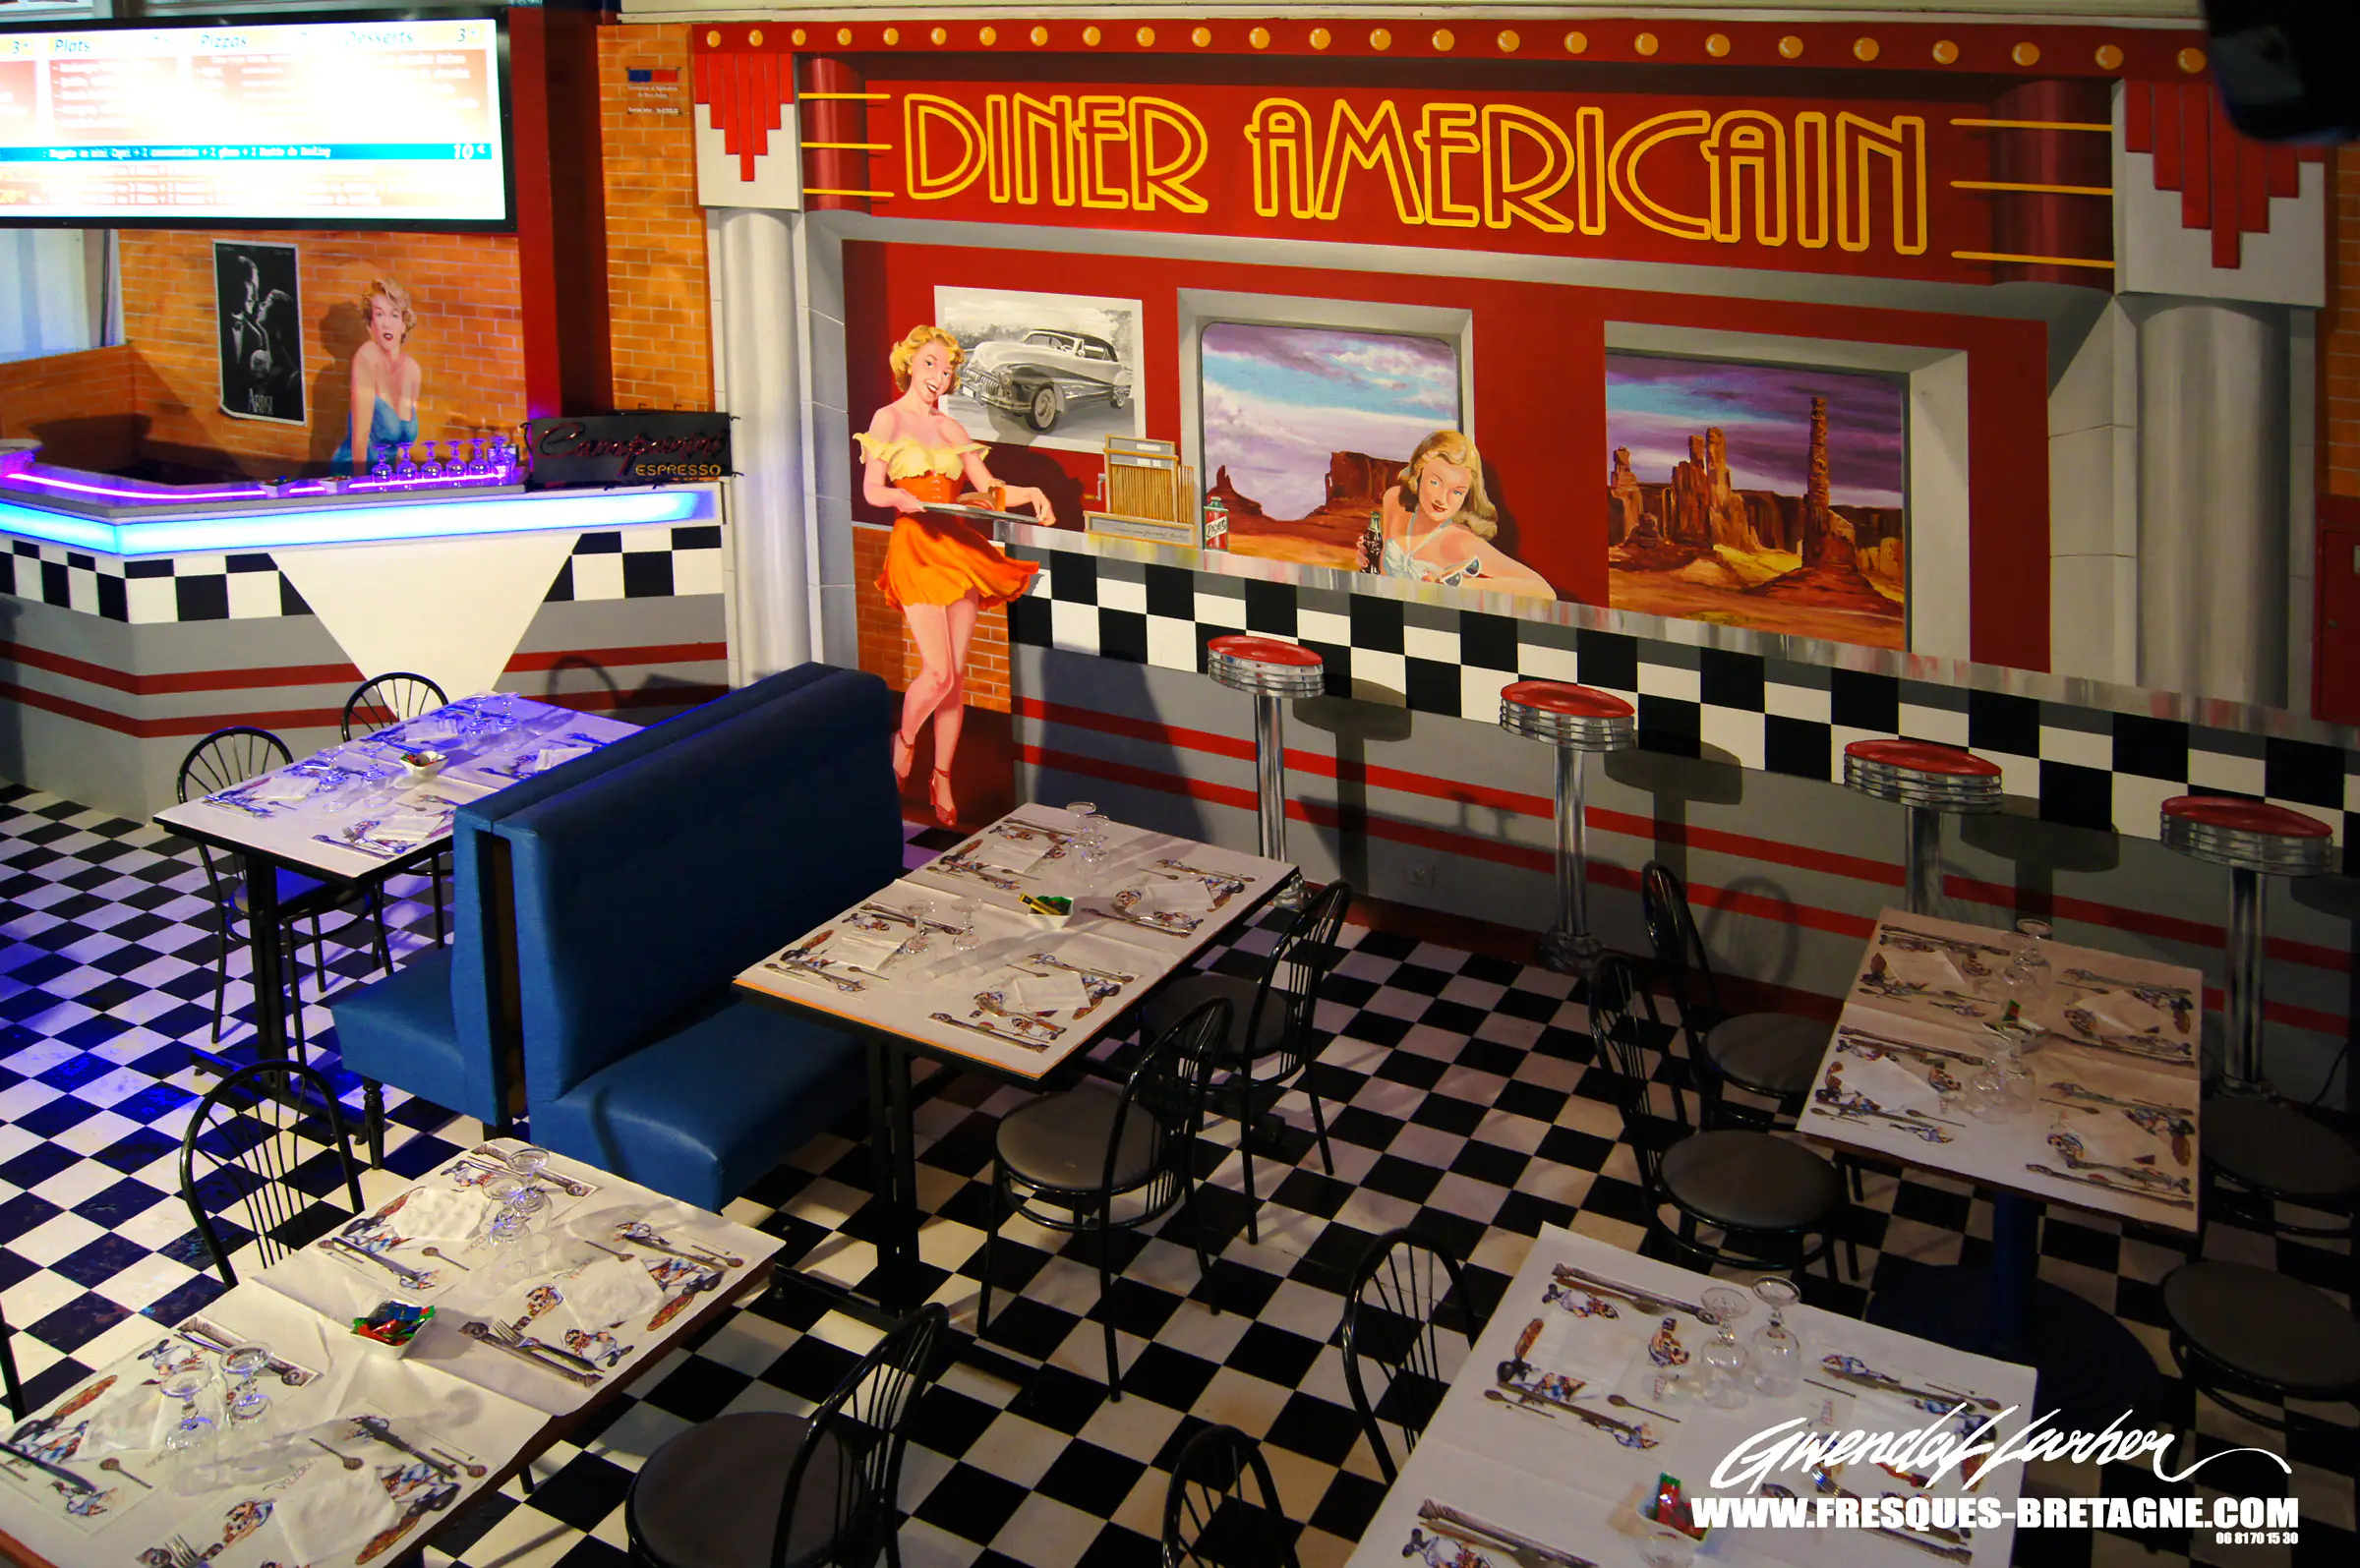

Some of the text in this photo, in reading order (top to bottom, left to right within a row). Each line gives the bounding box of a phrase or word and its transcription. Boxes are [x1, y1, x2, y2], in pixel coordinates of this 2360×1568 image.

[54, 38, 90, 52] Plats
[201, 33, 248, 49] Pizzas
[906, 92, 1927, 255] DINER AMERICAIN
[635, 463, 722, 477] ESPRESSO
